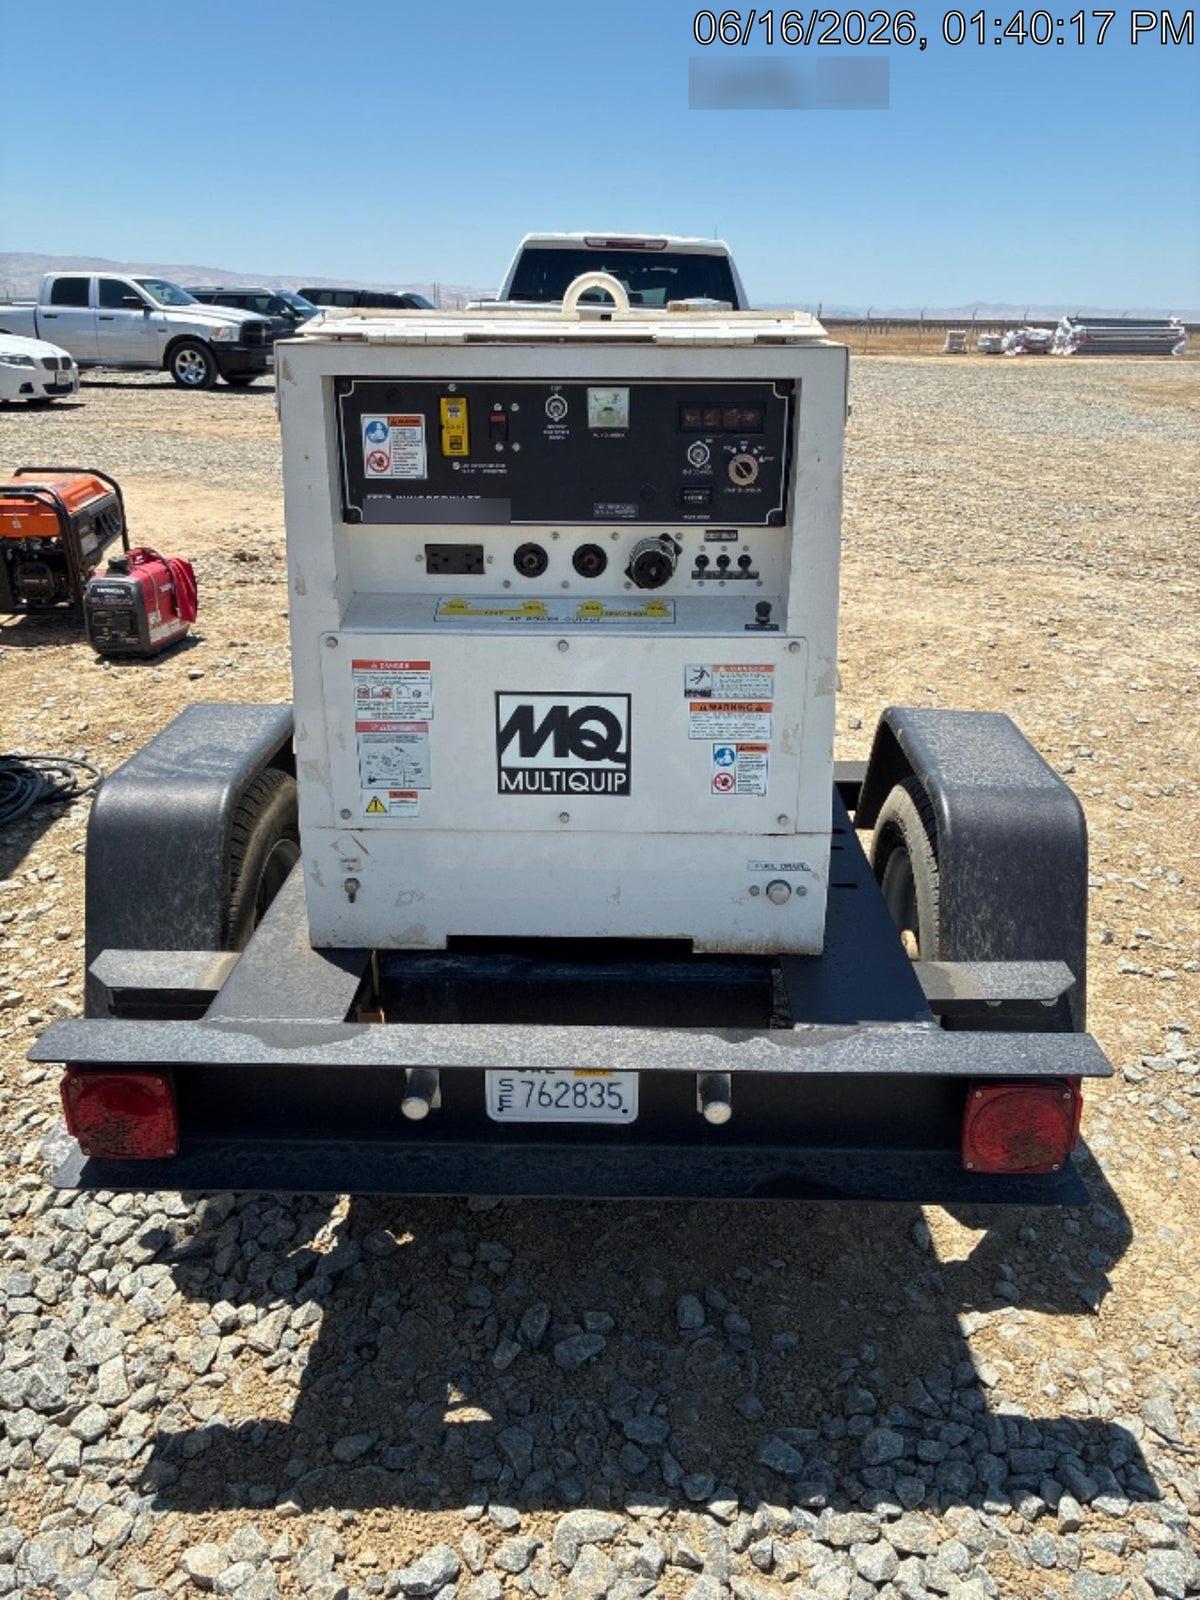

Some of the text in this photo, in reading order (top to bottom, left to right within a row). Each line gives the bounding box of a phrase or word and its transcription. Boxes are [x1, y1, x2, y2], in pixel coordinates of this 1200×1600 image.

[499, 705, 627, 764] MQ
[501, 771, 627, 792] MULTIQUIP
[520, 1080, 624, 1110] 762835
